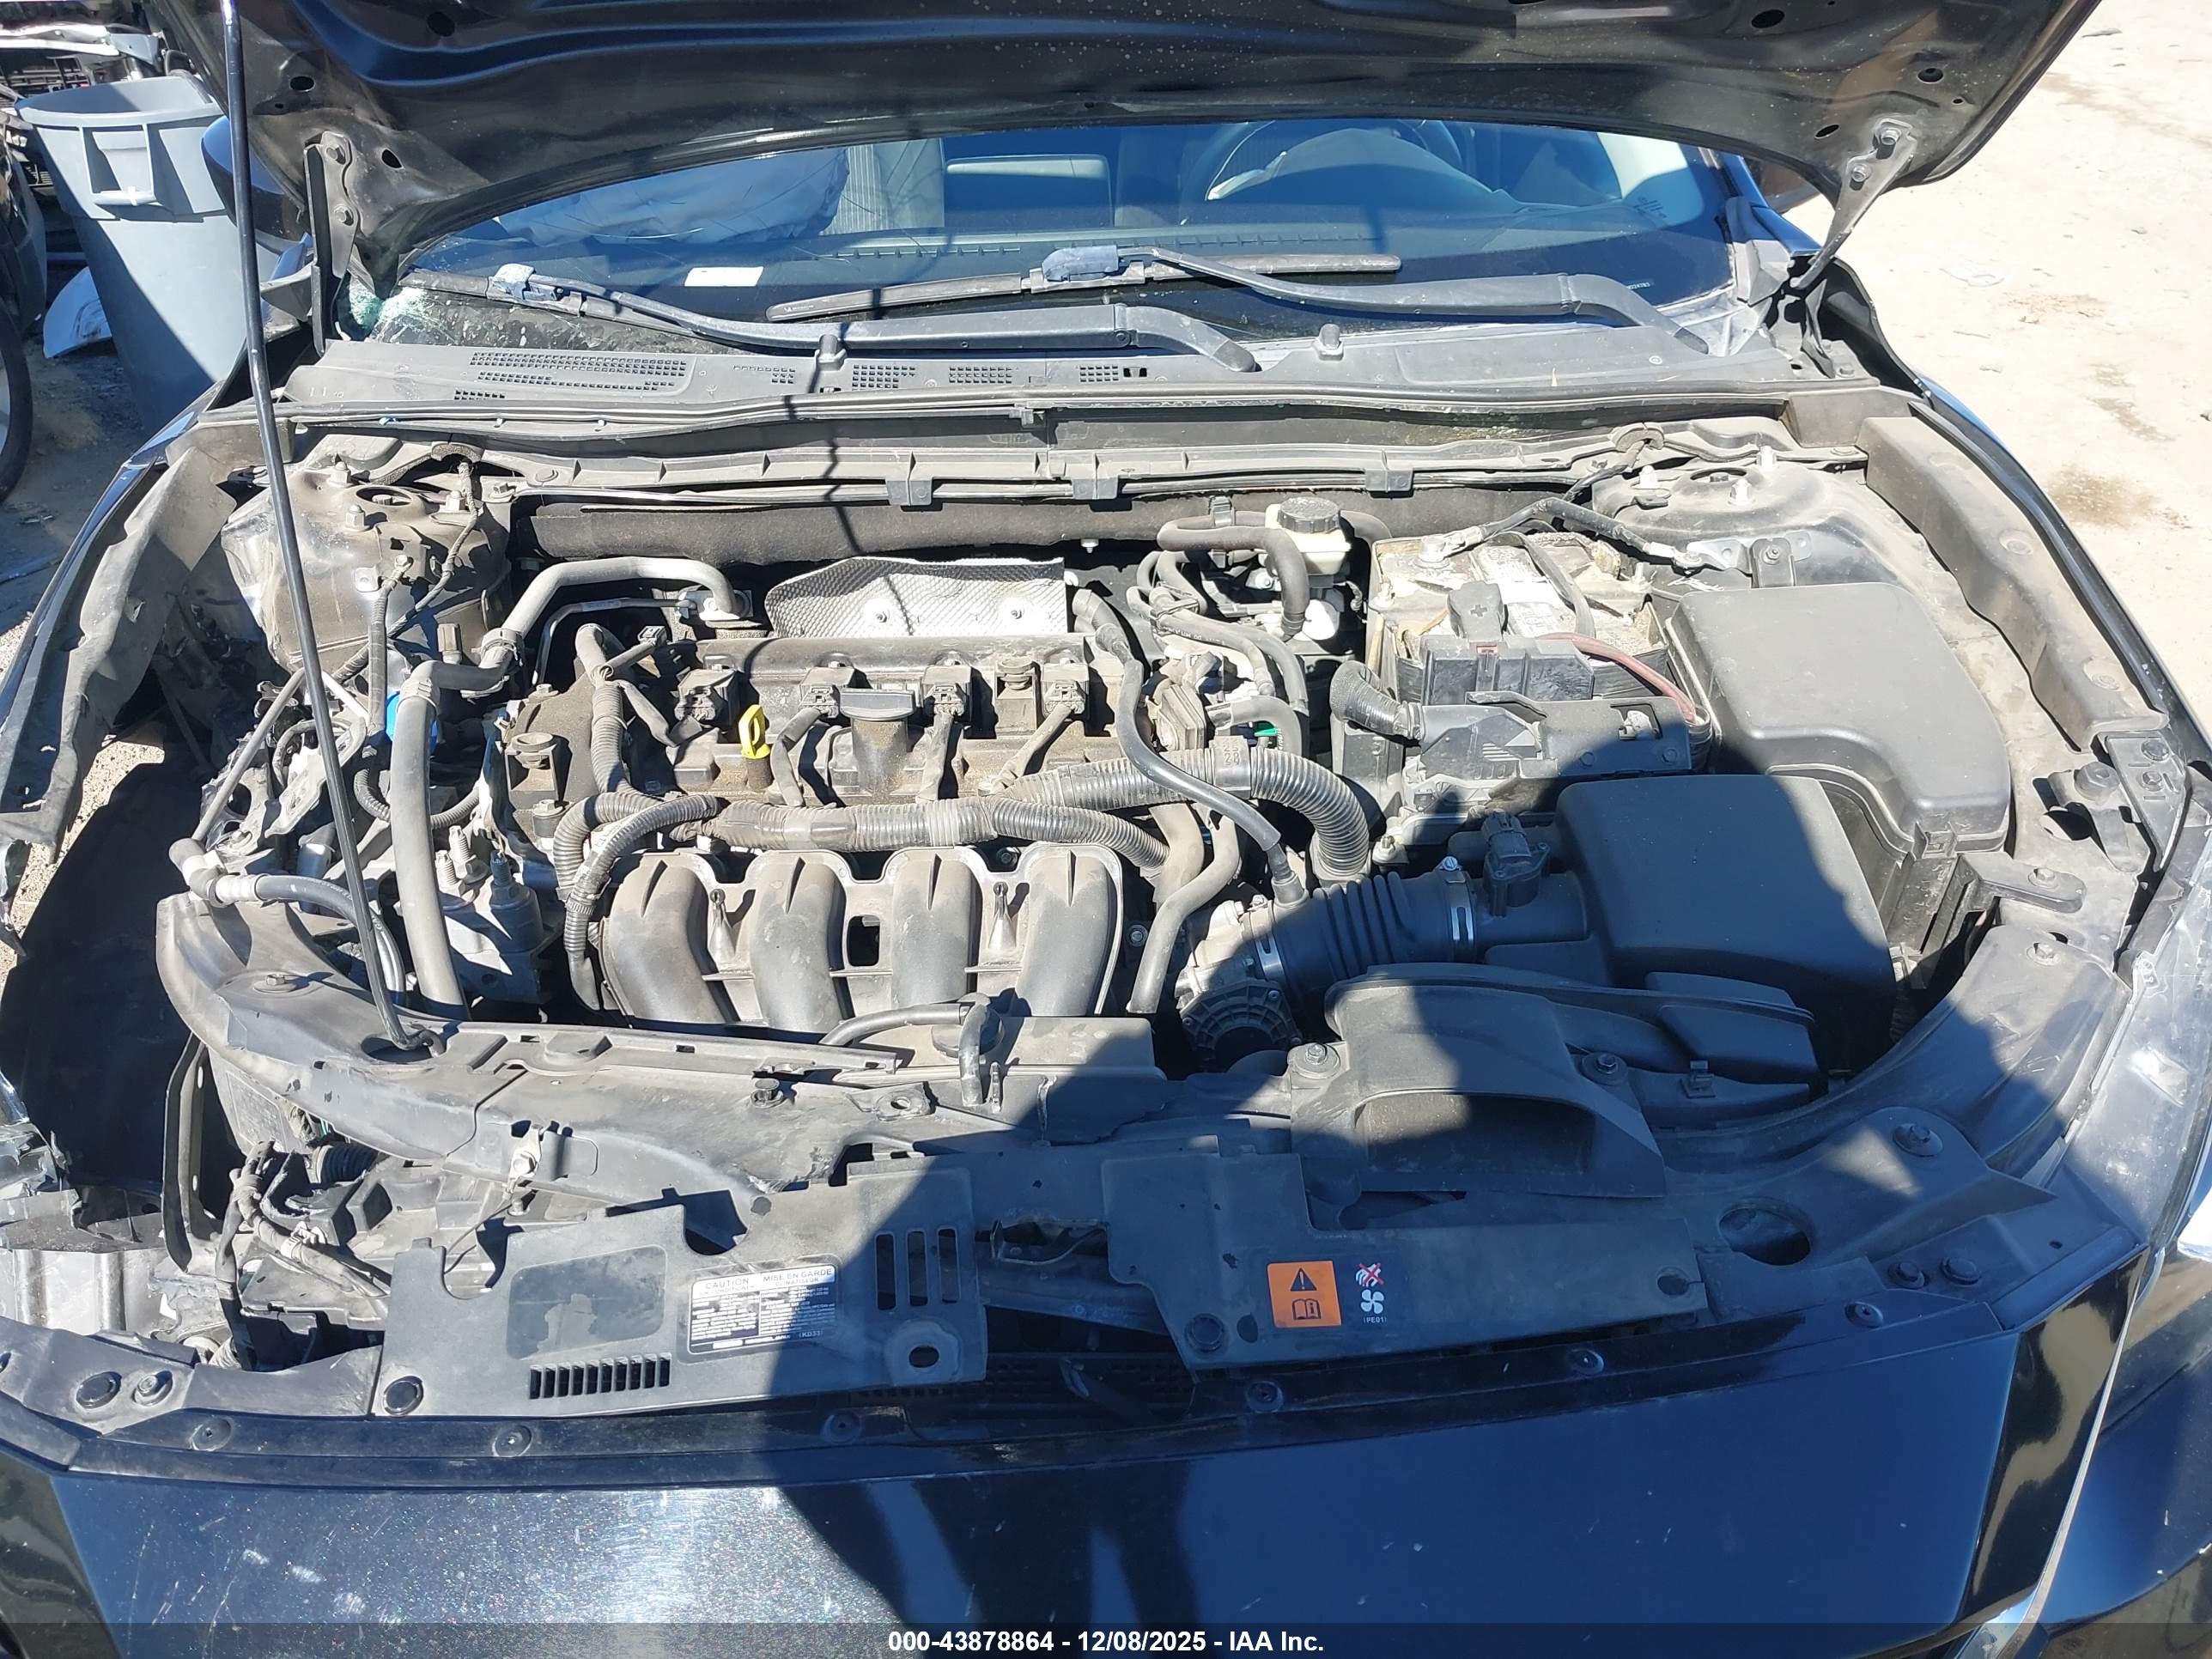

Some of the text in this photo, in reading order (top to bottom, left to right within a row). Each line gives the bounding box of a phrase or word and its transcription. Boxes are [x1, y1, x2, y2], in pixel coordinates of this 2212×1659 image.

[763, 1268, 832, 1283] MISE EN GARDE
[705, 1278, 750, 1290] CAUTION
